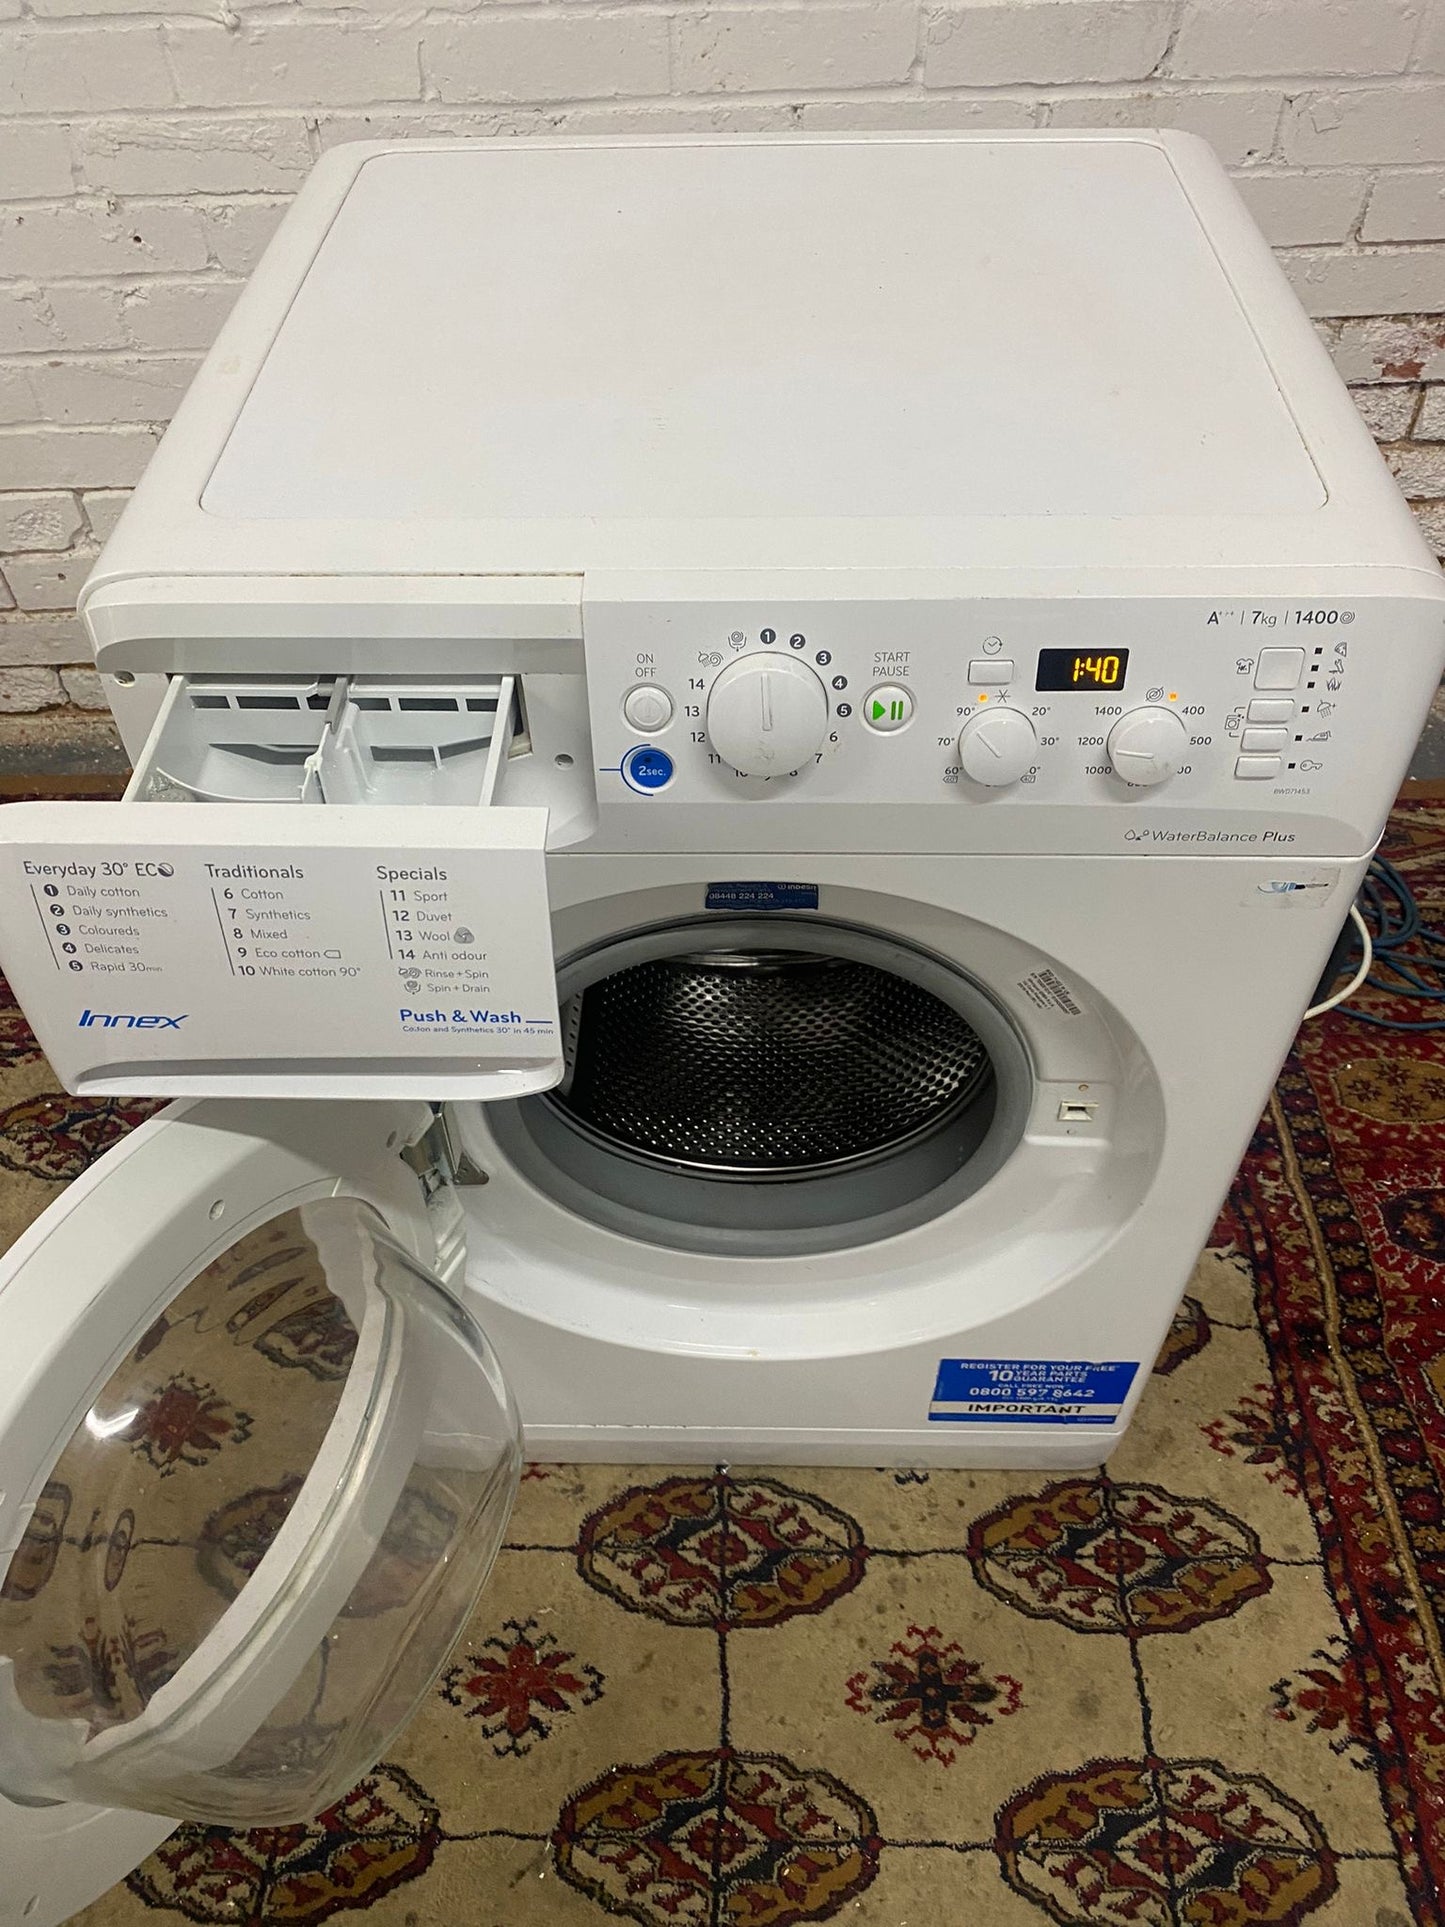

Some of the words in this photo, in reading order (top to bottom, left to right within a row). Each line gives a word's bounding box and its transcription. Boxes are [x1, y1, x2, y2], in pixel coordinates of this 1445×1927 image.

[1252, 611, 1277, 628] 7kg
[1296, 610, 1338, 624] 1400
[762, 630, 774, 642] 1
[792, 636, 803, 647] 2
[636, 654, 654, 664] ON
[818, 652, 829, 664] 3
[874, 652, 910, 663] START
[635, 667, 656, 678] OFF
[872, 666, 910, 676] PAUSE
[1073, 656, 1120, 683] 1:40
[688, 679, 706, 690] 14
[834, 678, 845, 688] 4
[685, 706, 700, 716] 13
[839, 705, 850, 716] 5
[1095, 706, 1122, 716] 1400
[1182, 706, 1204, 716] 400
[690, 732, 706, 742] 12
[830, 732, 838, 742] 6
[1078, 737, 1104, 746] 1200
[1190, 737, 1212, 746] 500
[708, 754, 720, 764] 11
[814, 753, 822, 764] 7
[1085, 766, 1112, 774] 1000
[1152, 830, 1257, 842] WaterBalance
[1262, 830, 1295, 842] Plus
[24, 861, 96, 878] Everyday
[204, 864, 304, 879] Traditionals
[376, 866, 448, 882] Specials
[46, 884, 56, 896] 1
[66, 886, 96, 898] Daily
[100, 888, 140, 897] cotton
[224, 888, 234, 900] 6
[241, 888, 284, 900] Cotton
[390, 890, 406, 901] 11
[414, 890, 448, 903] Sport
[52, 904, 62, 916] 2
[72, 905, 102, 918] Daily
[106, 907, 168, 918] synthetics
[228, 908, 237, 920] 7
[246, 908, 311, 922] Synthetics
[392, 910, 410, 922] 12
[416, 911, 452, 922] Duvet
[58, 924, 68, 935] 3
[78, 925, 140, 936] Coloureds
[234, 928, 243, 939] 8
[250, 929, 288, 939] Mixed
[396, 930, 412, 941] 13
[418, 931, 450, 942] Wool
[64, 942, 74, 953] 4
[85, 944, 139, 954] Delicates
[238, 947, 247, 958] 9
[256, 948, 278, 958] Eco
[282, 949, 321, 958] cotton
[398, 950, 415, 960] 14
[423, 950, 447, 960] Anti
[451, 951, 488, 960] odour
[70, 960, 81, 971] 5
[90, 962, 126, 973] Rapid
[238, 966, 256, 976] 10
[259, 966, 295, 976] White
[298, 967, 336, 976] cotton
[425, 969, 454, 978] Rinse
[464, 970, 488, 980] Spin
[428, 984, 451, 994] Spin
[462, 984, 490, 992] Drain
[78, 1010, 189, 1029] Innex
[400, 1008, 446, 1022] Push
[452, 1010, 468, 1022] &
[470, 1010, 522, 1024] Wash
[452, 1026, 494, 1034] Synthetics
[989, 1370, 1013, 1382] 10
[970, 1388, 1012, 1396] 0800
[1017, 1388, 1048, 1396] 597
[1053, 1389, 1094, 1398] 8642
[968, 1404, 1086, 1413] IMPORTANT
